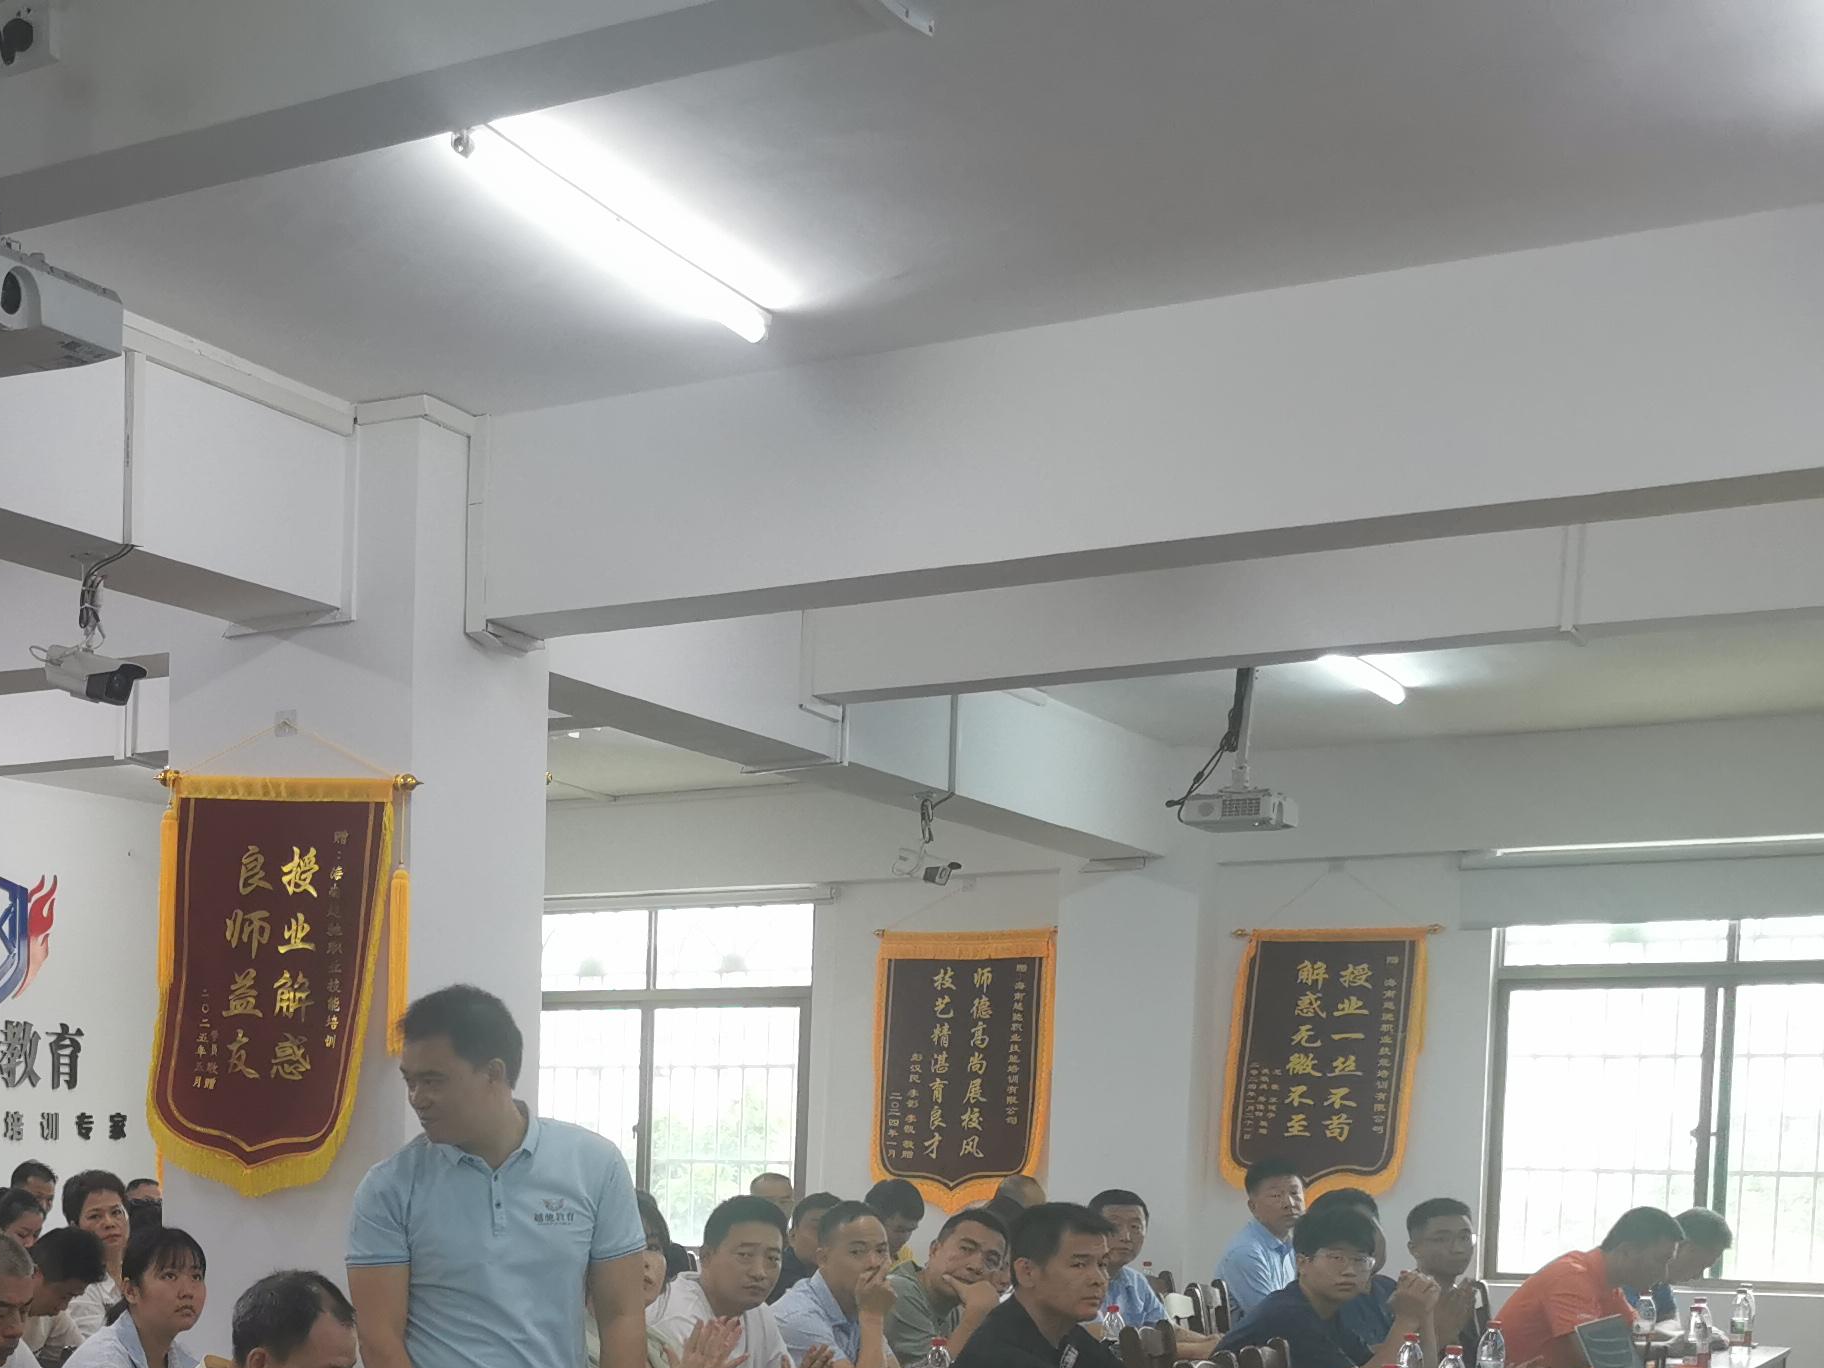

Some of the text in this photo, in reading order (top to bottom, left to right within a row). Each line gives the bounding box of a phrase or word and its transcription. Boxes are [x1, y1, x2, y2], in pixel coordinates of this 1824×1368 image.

[221, 845, 273, 1081] 良师益友
[270, 846, 321, 1081] 授业解惑
[1283, 959, 1329, 1138] 解惑无微不至
[1321, 963, 1373, 1143] 授业一丝不苟
[923, 966, 957, 1160] 技艺精湛育良才
[959, 966, 994, 1158] 师德高尚展校风
